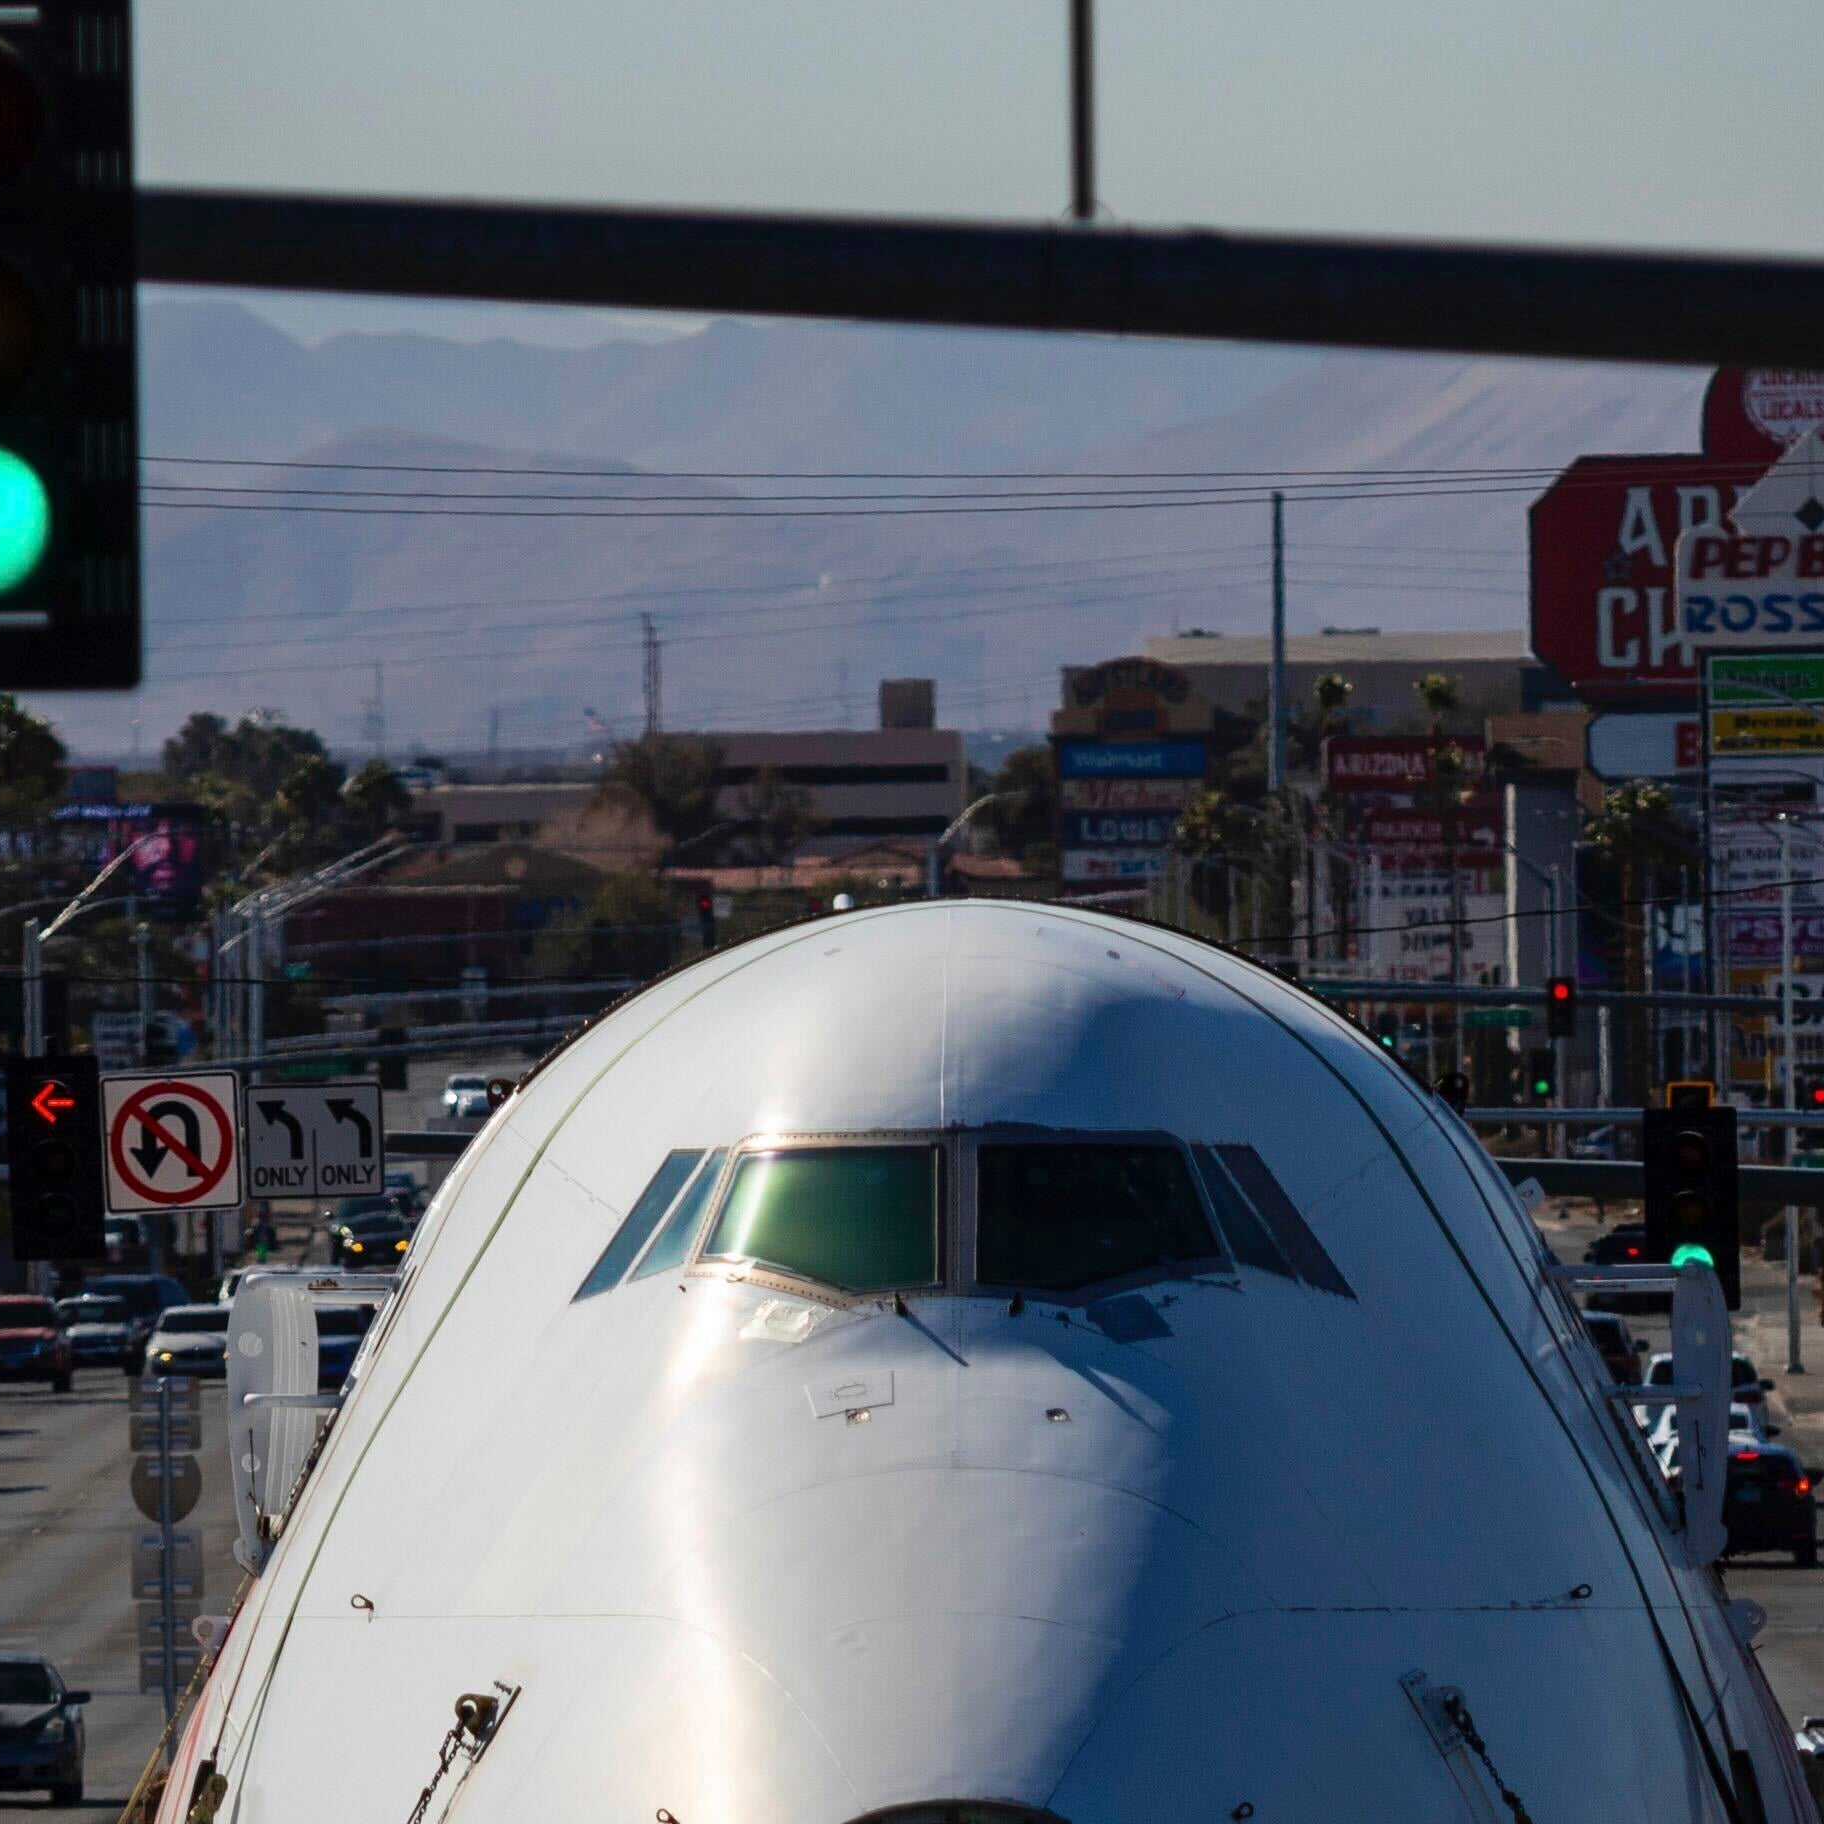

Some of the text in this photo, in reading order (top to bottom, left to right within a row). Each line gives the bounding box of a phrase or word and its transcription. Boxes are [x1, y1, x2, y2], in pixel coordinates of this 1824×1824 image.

[1689, 535, 1793, 579] PEP
[254, 1164, 376, 1188] ONLY ONLY
